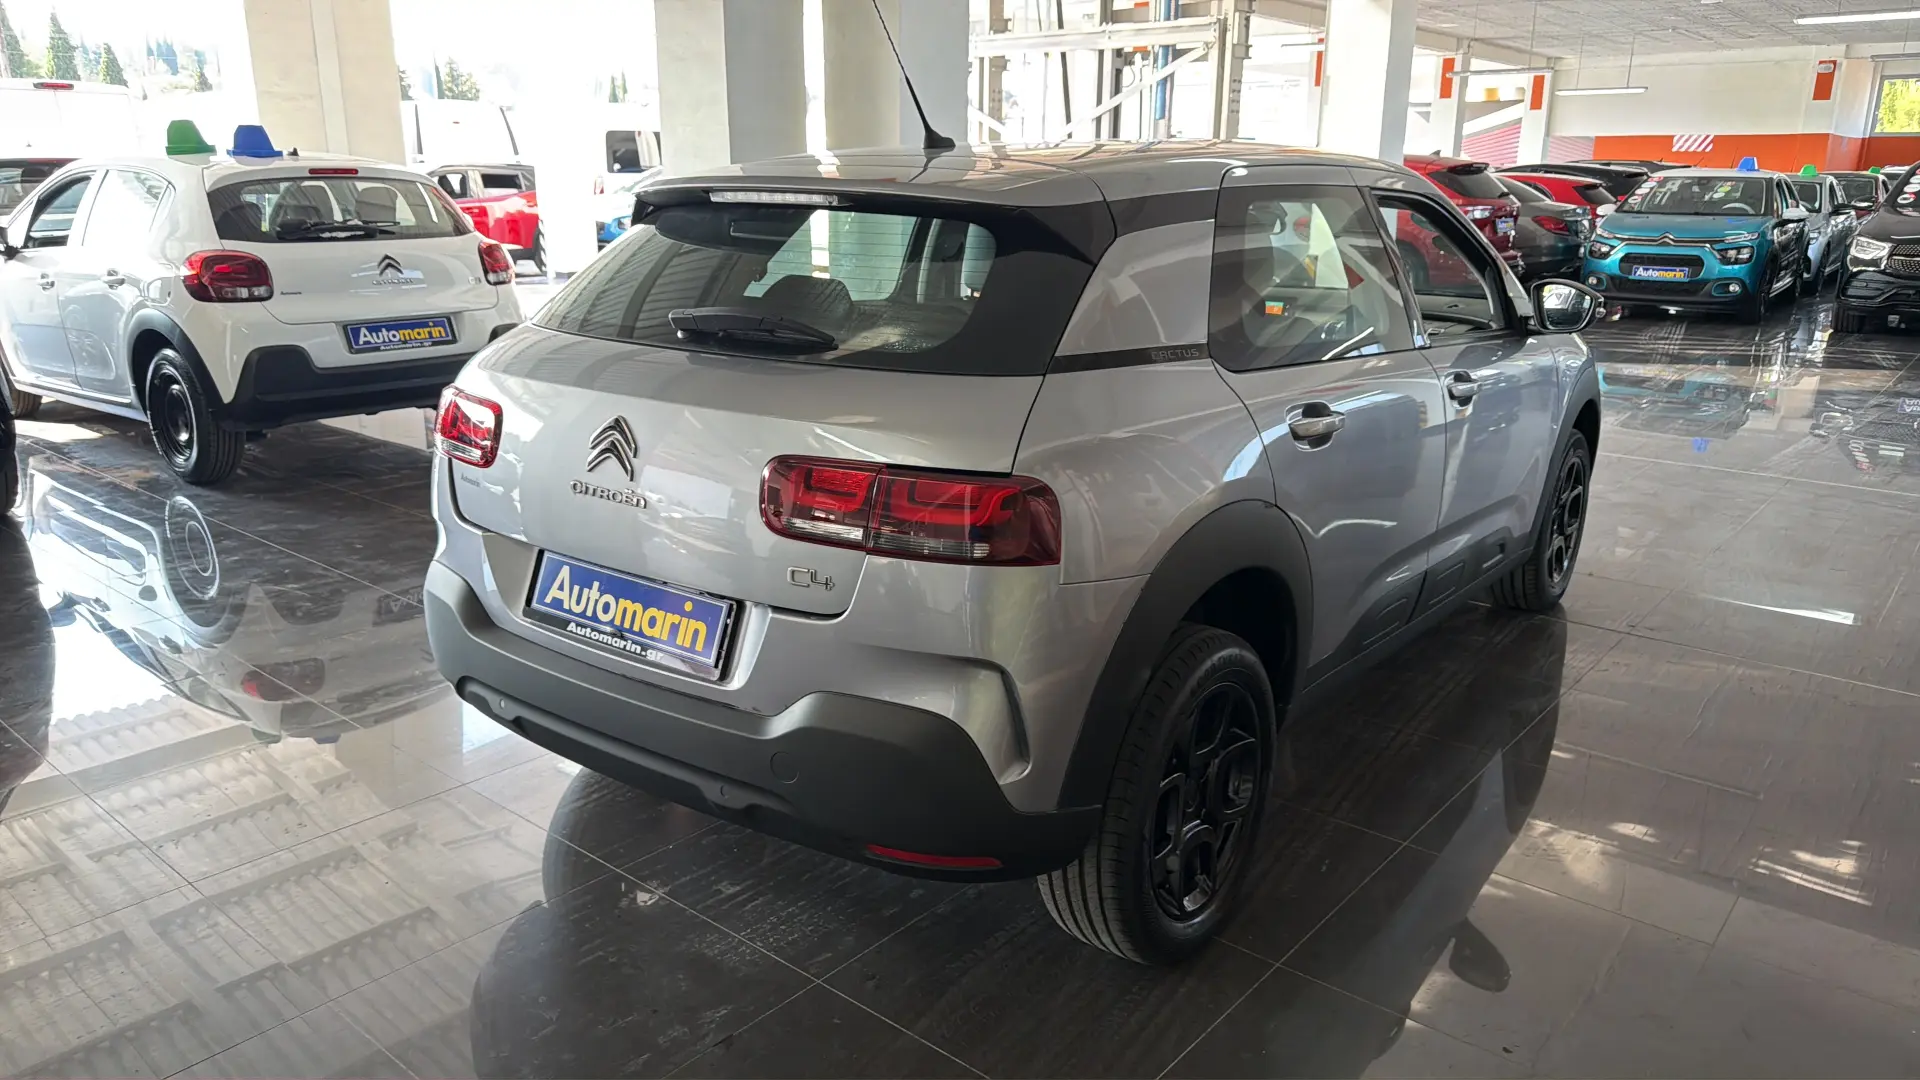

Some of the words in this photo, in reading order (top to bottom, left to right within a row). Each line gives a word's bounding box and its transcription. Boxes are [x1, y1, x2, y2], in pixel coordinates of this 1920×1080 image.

[1636, 266, 1685, 278] Automarin
[358, 321, 446, 345] Automarin
[786, 566, 835, 591] C4
[543, 565, 707, 652] Automarin
[565, 621, 664, 661] Automarin.gr
